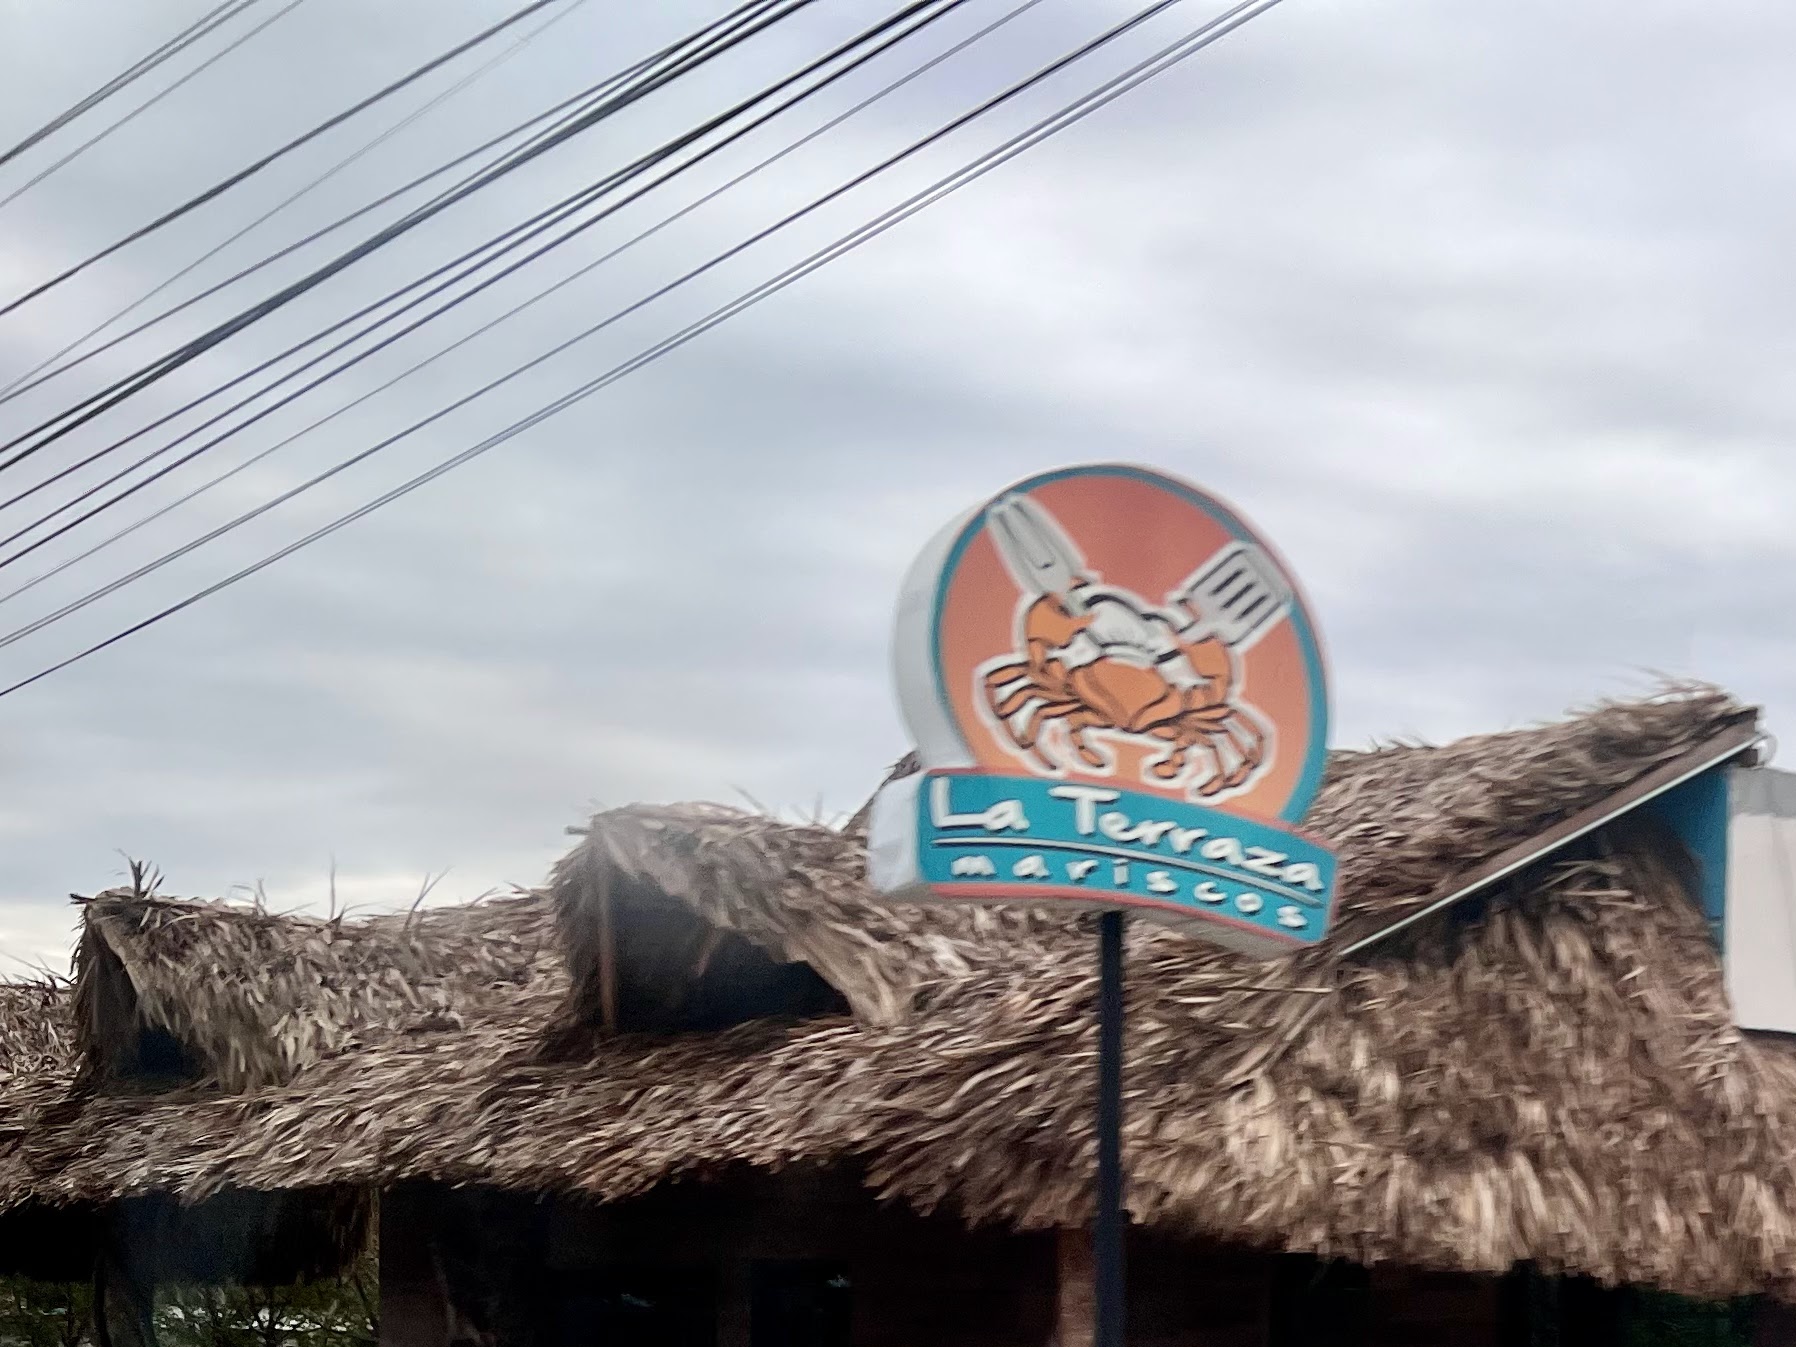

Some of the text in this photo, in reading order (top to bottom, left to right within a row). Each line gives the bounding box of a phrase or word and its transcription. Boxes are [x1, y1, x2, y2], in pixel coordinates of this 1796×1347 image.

[930, 776, 1325, 892] La Terraza
[950, 854, 1309, 928] mariscos
